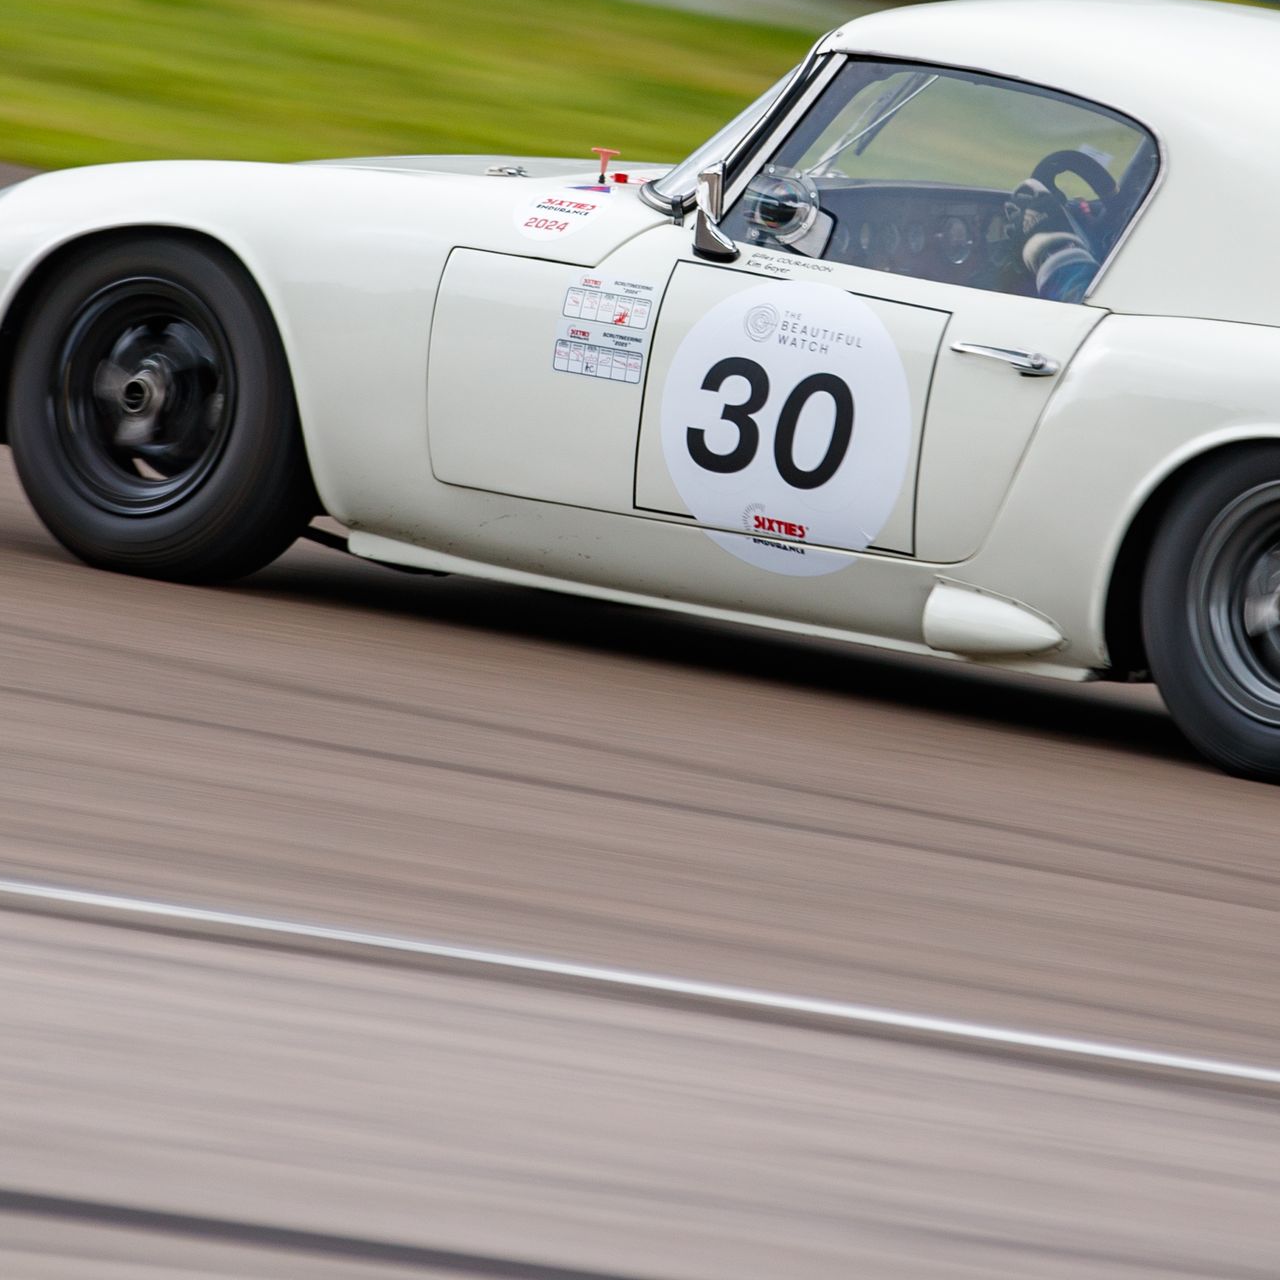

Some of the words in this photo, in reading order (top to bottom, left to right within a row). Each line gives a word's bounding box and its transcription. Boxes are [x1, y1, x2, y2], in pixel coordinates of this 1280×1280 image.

[536, 204, 589, 216] ENDURANCE
[542, 199, 597, 211] SIXTIES
[523, 217, 570, 232] 2024
[784, 310, 802, 320] THE
[778, 333, 829, 354] WATCH
[780, 320, 863, 349] BEAUTIFUL
[686, 356, 855, 490] 30
[753, 515, 806, 538] SIXTIES
